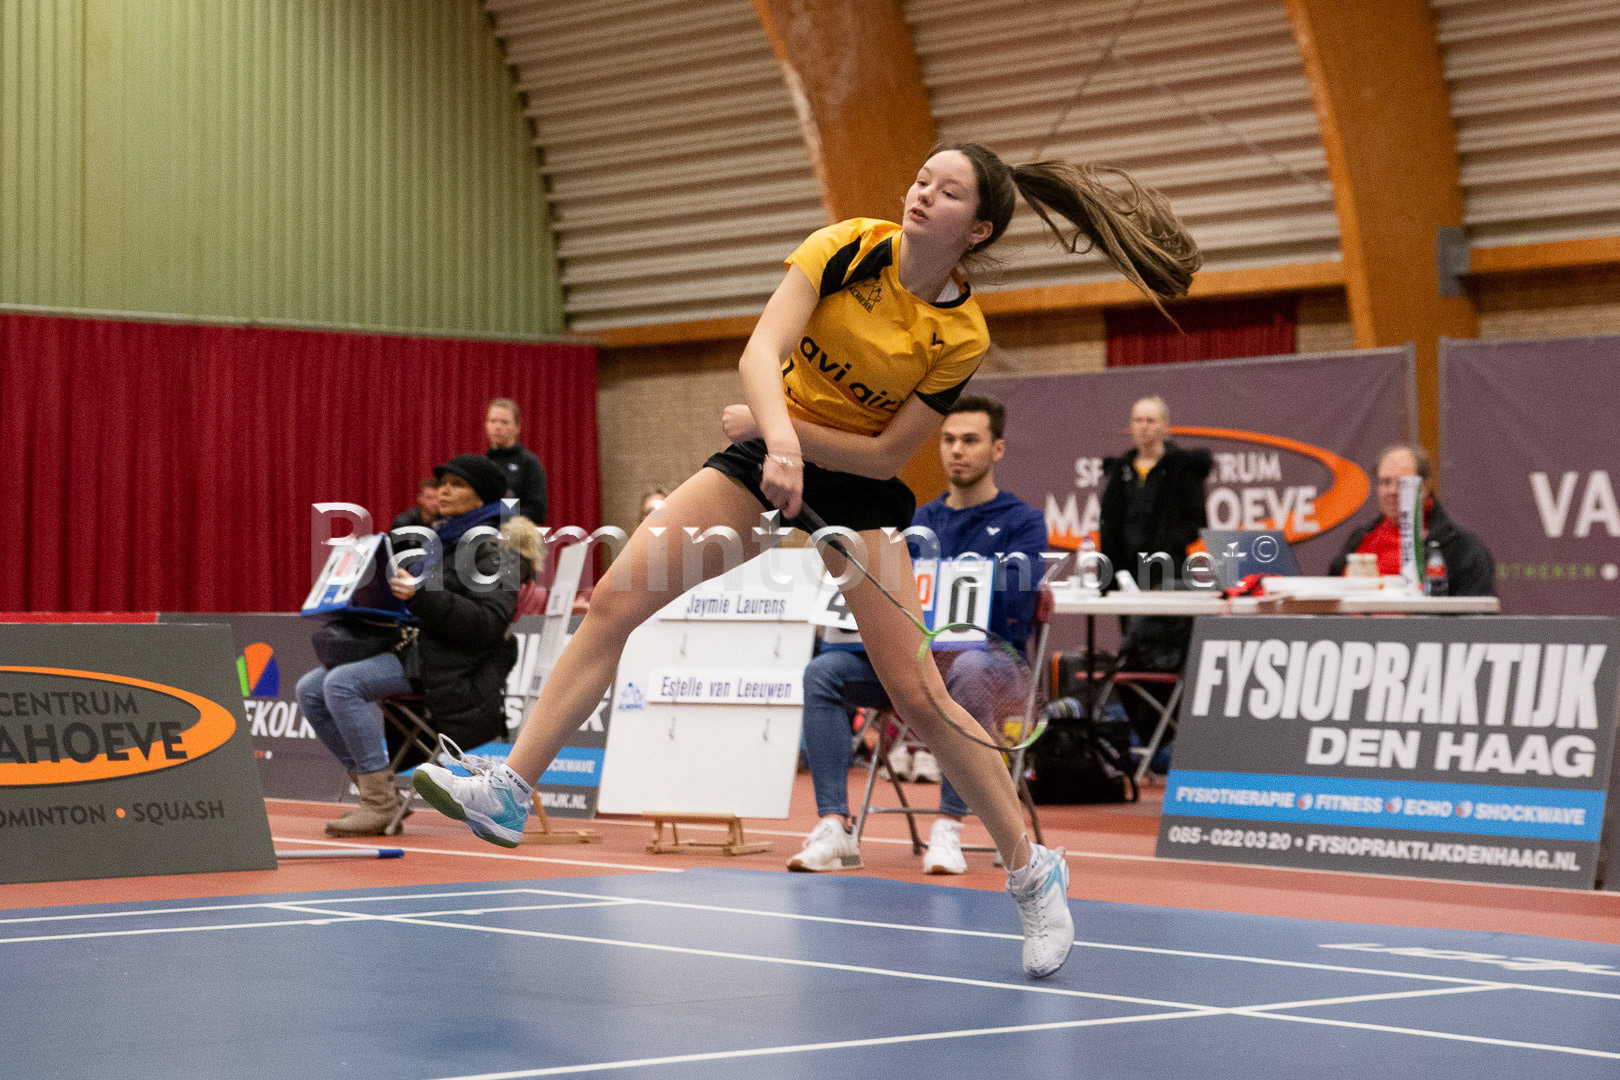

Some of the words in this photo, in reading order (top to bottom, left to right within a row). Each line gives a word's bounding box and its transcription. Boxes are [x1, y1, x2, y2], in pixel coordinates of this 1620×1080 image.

[686, 594, 730, 617] Jaymie
[736, 594, 786, 615] Laurens
[661, 676, 702, 697] Estelle
[709, 682, 731, 698] van
[737, 678, 792, 699] Leeuwen
[1192, 639, 1607, 729] FYSIOPRAKTIJK
[1305, 727, 1421, 769] DEN
[1434, 732, 1597, 778] HAAG
[132, 799, 225, 826] SQUASH
[1175, 786, 1295, 808] FYSIOTHERAPIE
[1315, 793, 1383, 813] FITNESS
[1403, 798, 1453, 817] ECHO
[1473, 802, 1587, 826] SHOCKWAVE
[1305, 833, 1582, 872] FYSIOPRAKTIJKDENHAAG.NL
